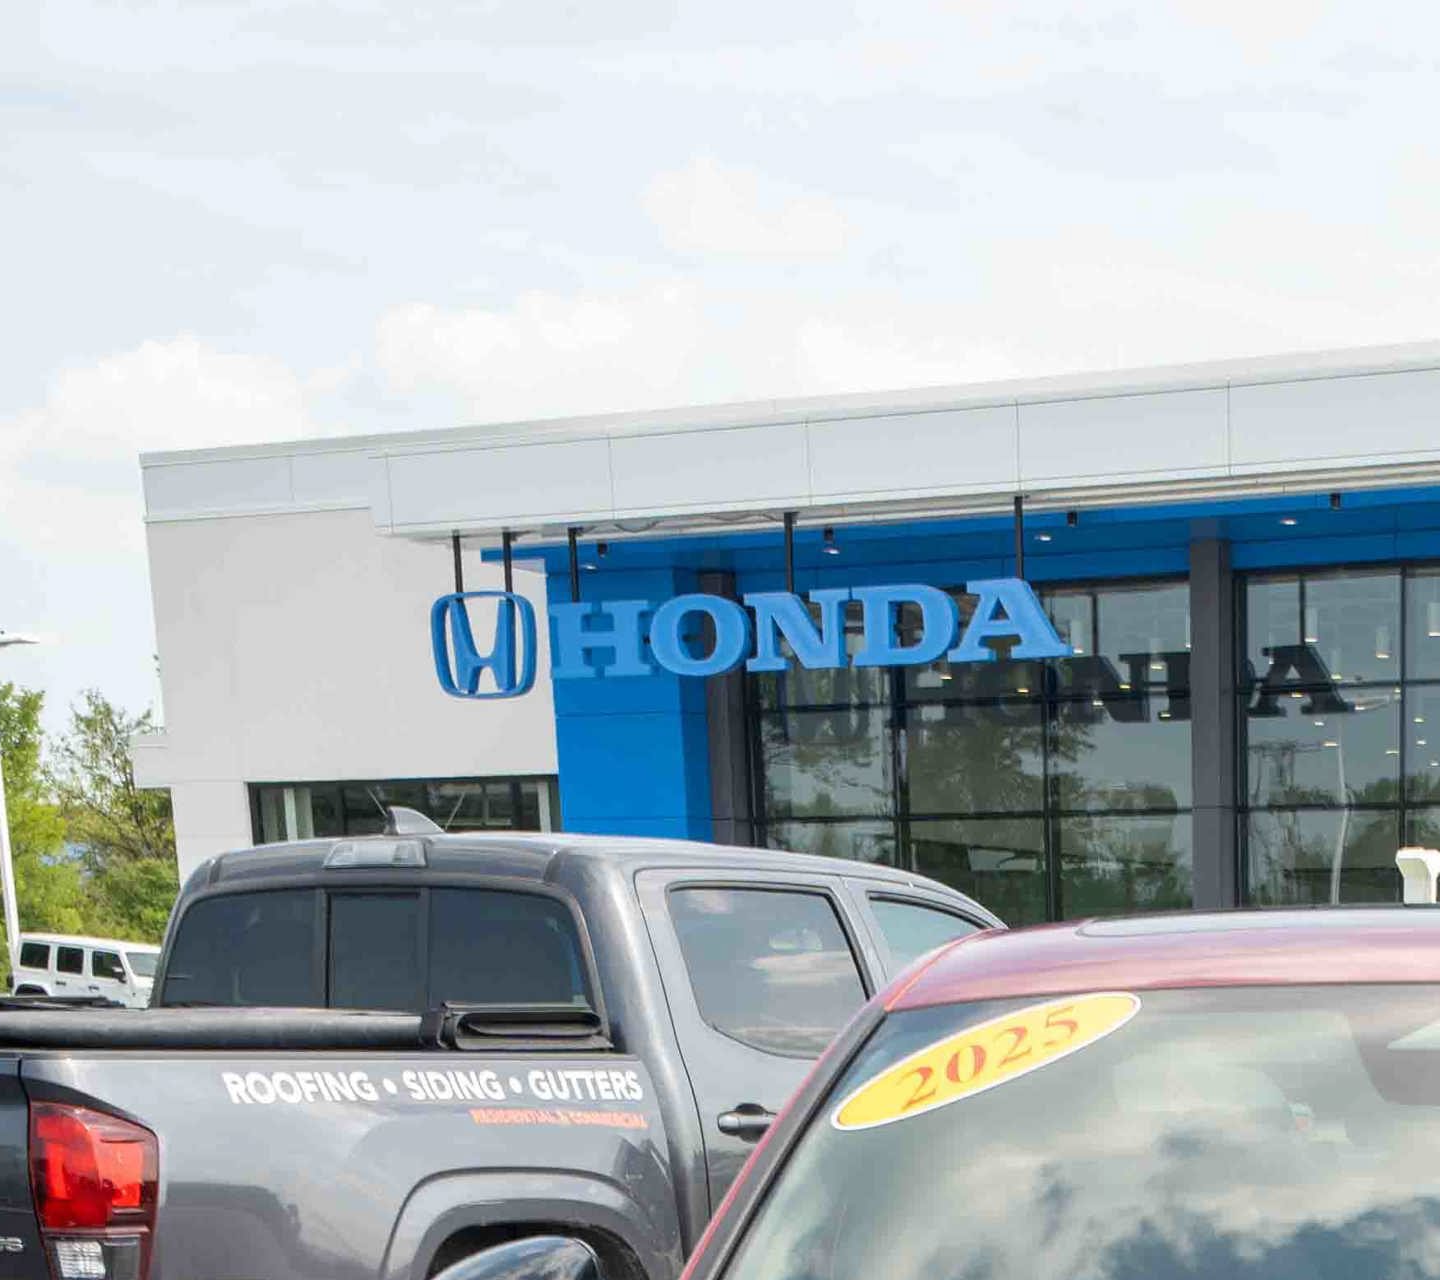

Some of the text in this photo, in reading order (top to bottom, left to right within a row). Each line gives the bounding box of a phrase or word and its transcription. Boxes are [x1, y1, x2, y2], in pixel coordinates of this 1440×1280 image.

[547, 577, 1073, 678] HONDA
[221, 1069, 644, 1104] ROOFING SIDING GUTTERS
[894, 1004, 1080, 1112] 2025
